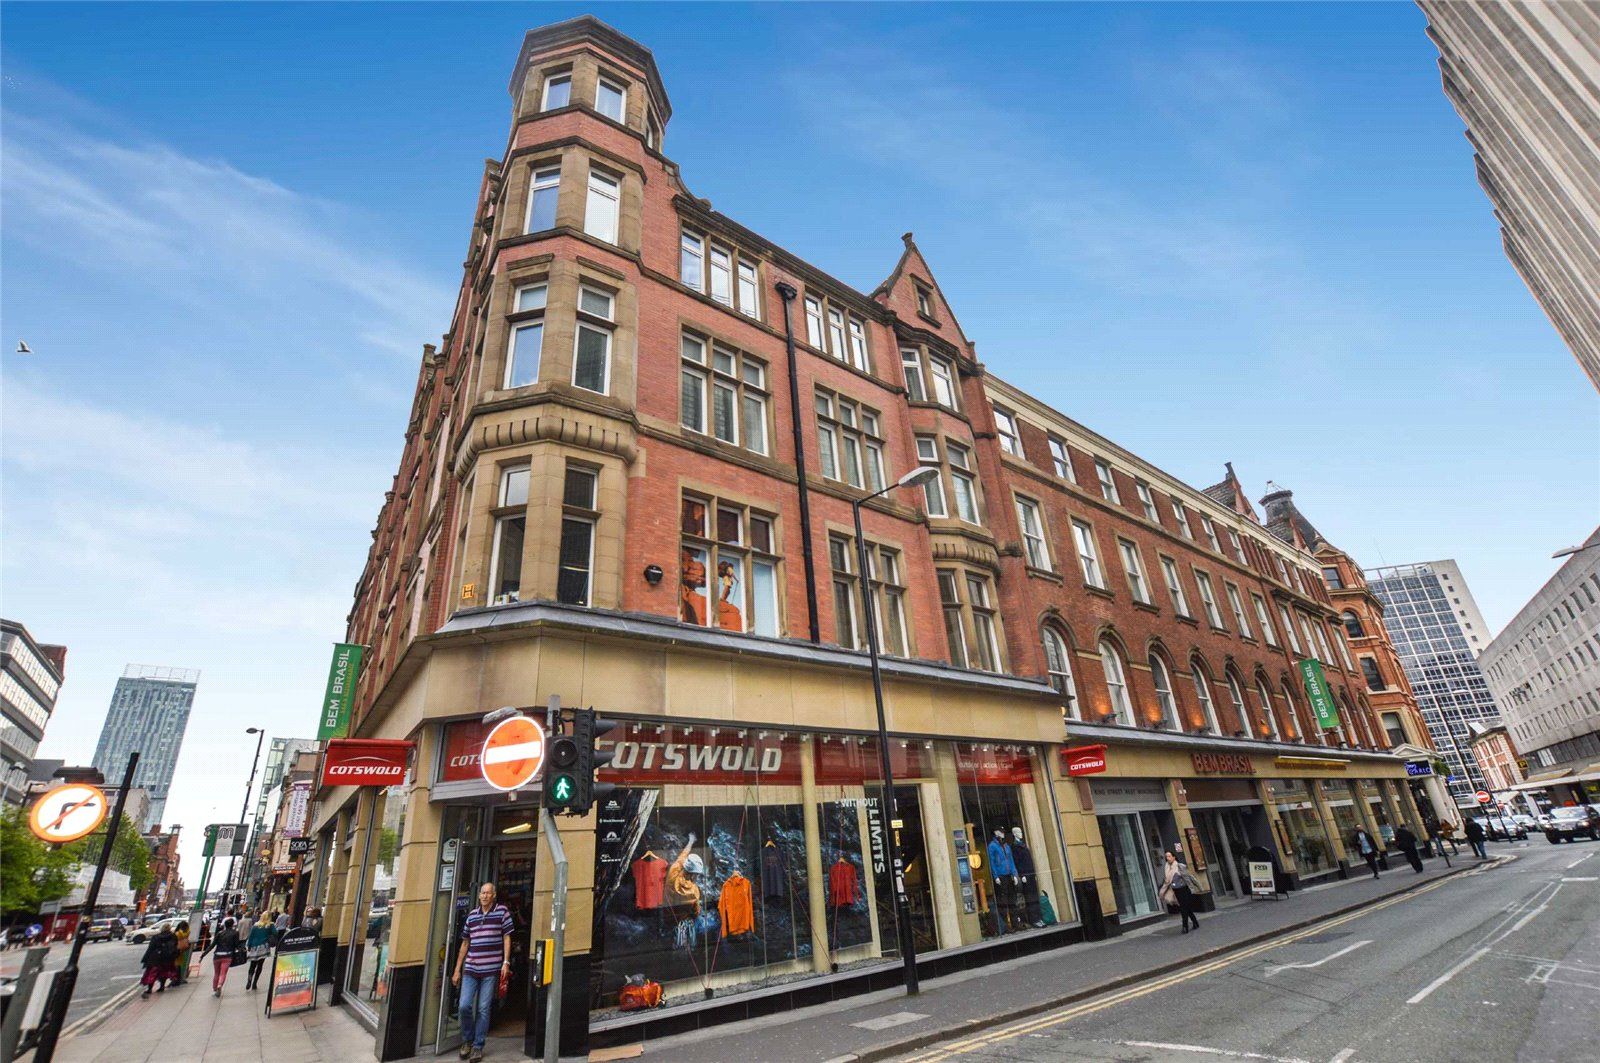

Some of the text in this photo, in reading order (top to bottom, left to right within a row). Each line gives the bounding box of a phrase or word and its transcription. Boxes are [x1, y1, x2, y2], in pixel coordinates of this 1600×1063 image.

[463, 586, 473, 597] H
[332, 649, 351, 694] BRASIL
[1304, 663, 1320, 696] BRASIL
[325, 698, 340, 728] BEM
[1315, 698, 1328, 718] BEM
[329, 765, 402, 775] COTSWOLD
[1070, 760, 1104, 770] COTSWOLD
[1195, 753, 1219, 772] BEM
[1217, 754, 1256, 774] BRASIL
[841, 798, 878, 808] WITHOUT
[869, 809, 885, 874] LIMITS
[278, 974, 310, 986] SAVINGS
